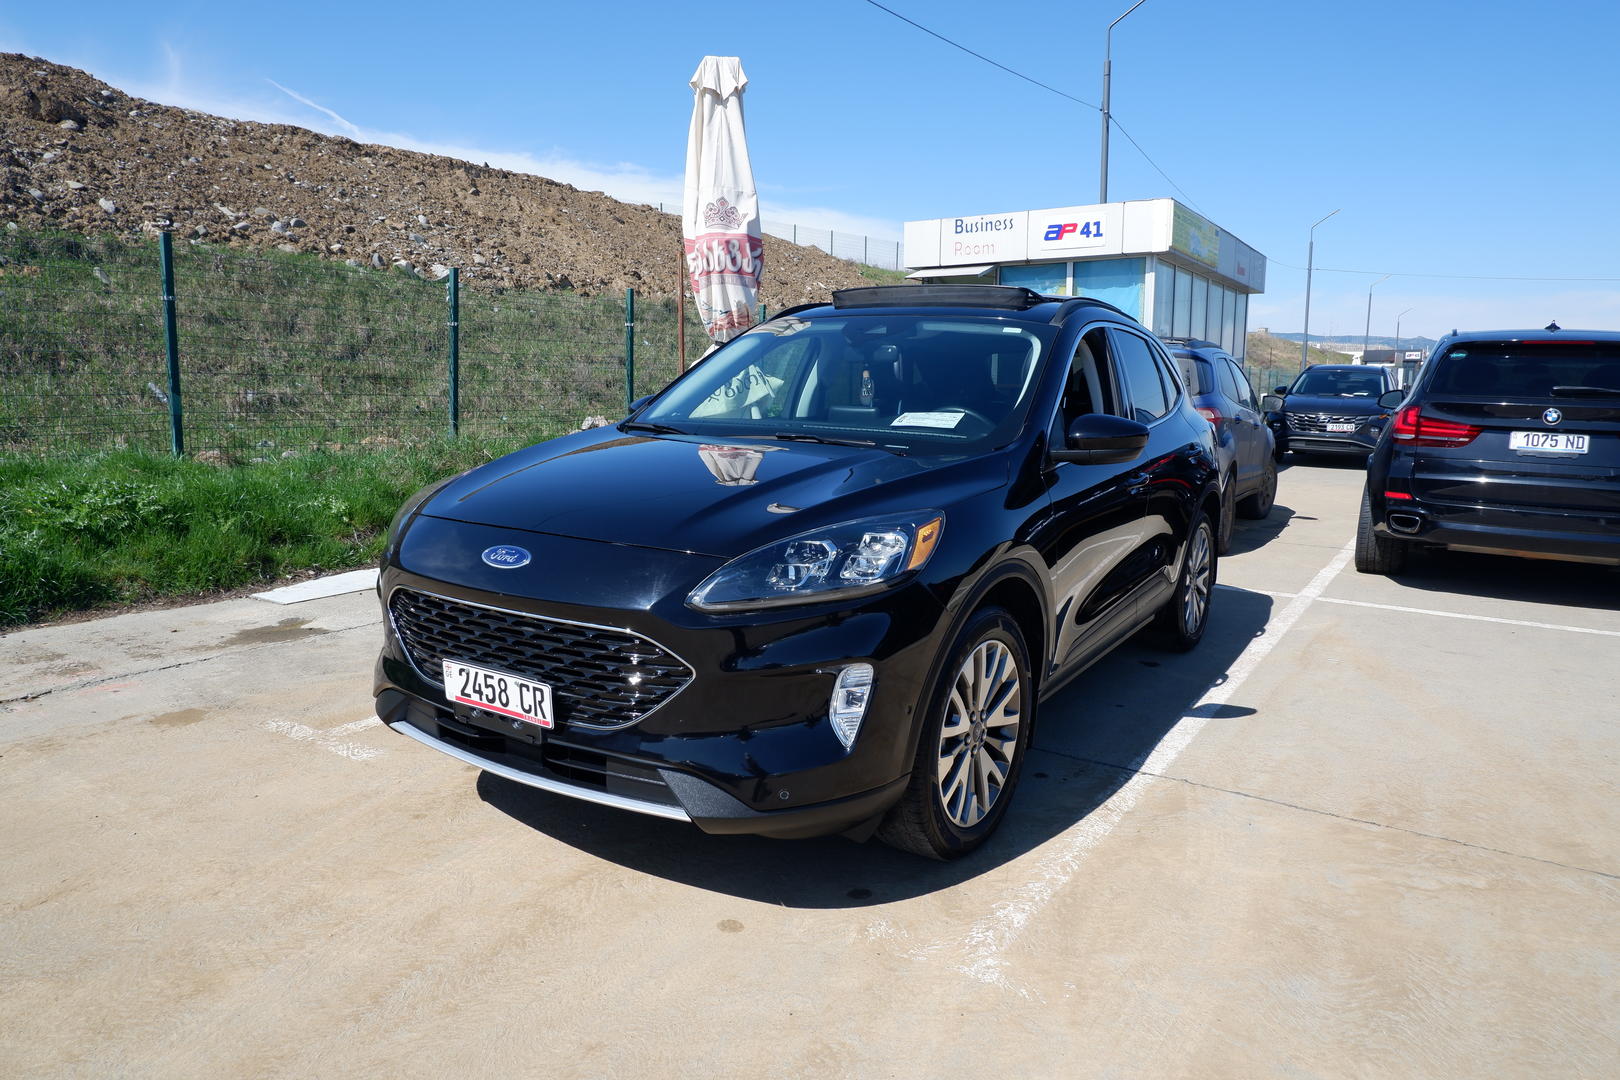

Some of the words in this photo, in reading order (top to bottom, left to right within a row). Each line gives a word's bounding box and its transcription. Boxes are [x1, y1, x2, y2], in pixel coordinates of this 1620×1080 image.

[954, 216, 1014, 235] Business
[1079, 220, 1104, 238] 41
[954, 241, 996, 257] Room
[1523, 433, 1559, 448] 1075
[1565, 435, 1586, 450] ND
[490, 548, 520, 563] Ford
[458, 667, 510, 708] 2458
[519, 682, 547, 720] CR
